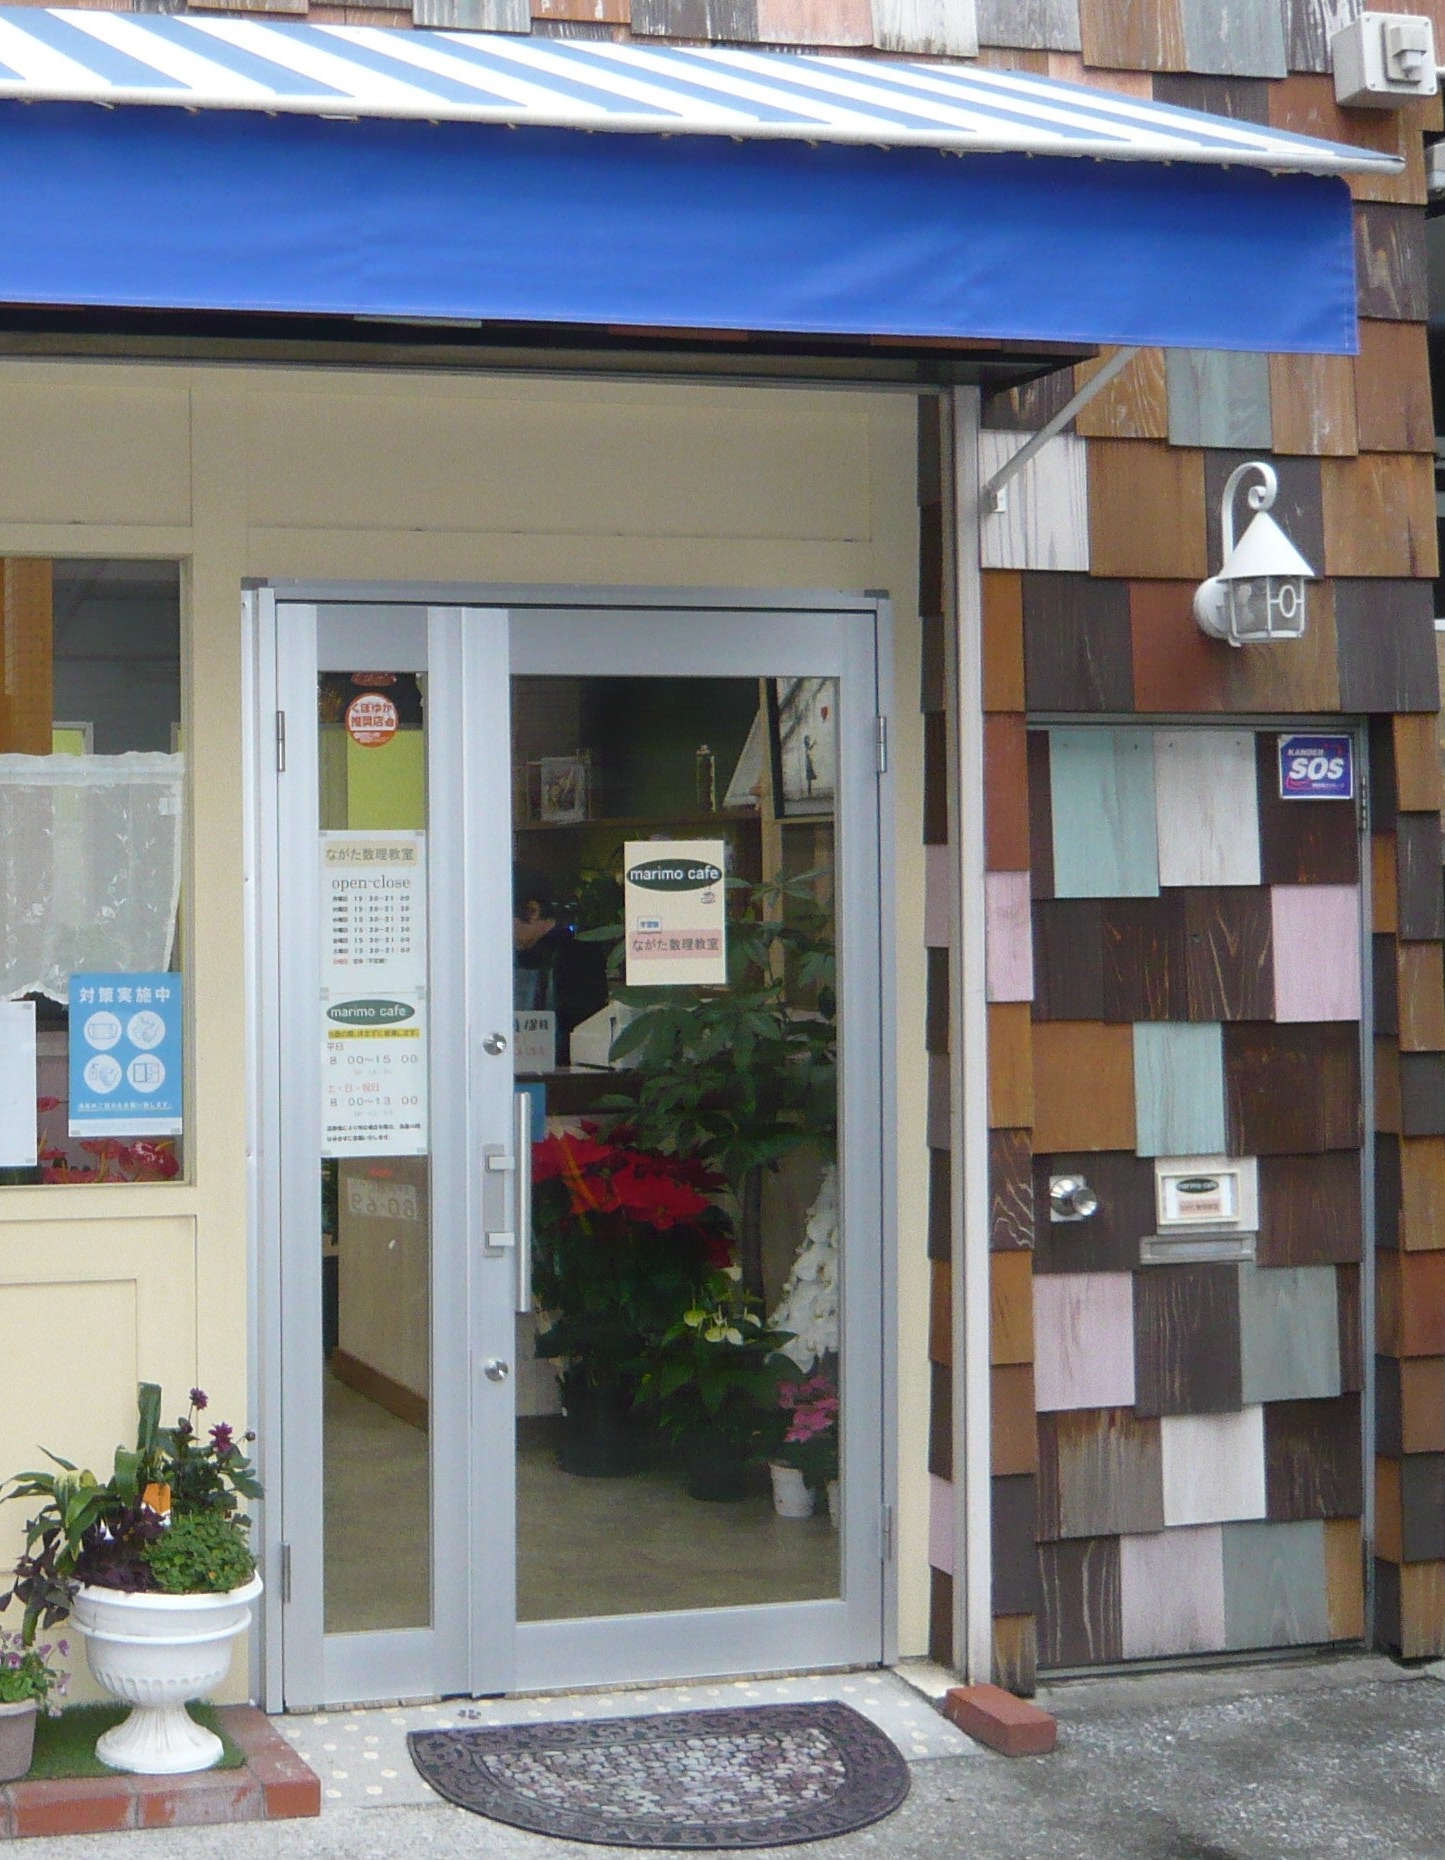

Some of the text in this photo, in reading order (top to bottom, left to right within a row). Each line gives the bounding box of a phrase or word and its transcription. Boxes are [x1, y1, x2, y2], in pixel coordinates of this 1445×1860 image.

[1289, 757, 1344, 780] SOS
[326, 848, 414, 862] ながた数理教室
[630, 865, 720, 881] marimo cafe
[632, 938, 719, 952] ながた数理教室
[79, 986, 171, 1004] 対策実施中
[330, 1004, 406, 1017] marimo cafe
